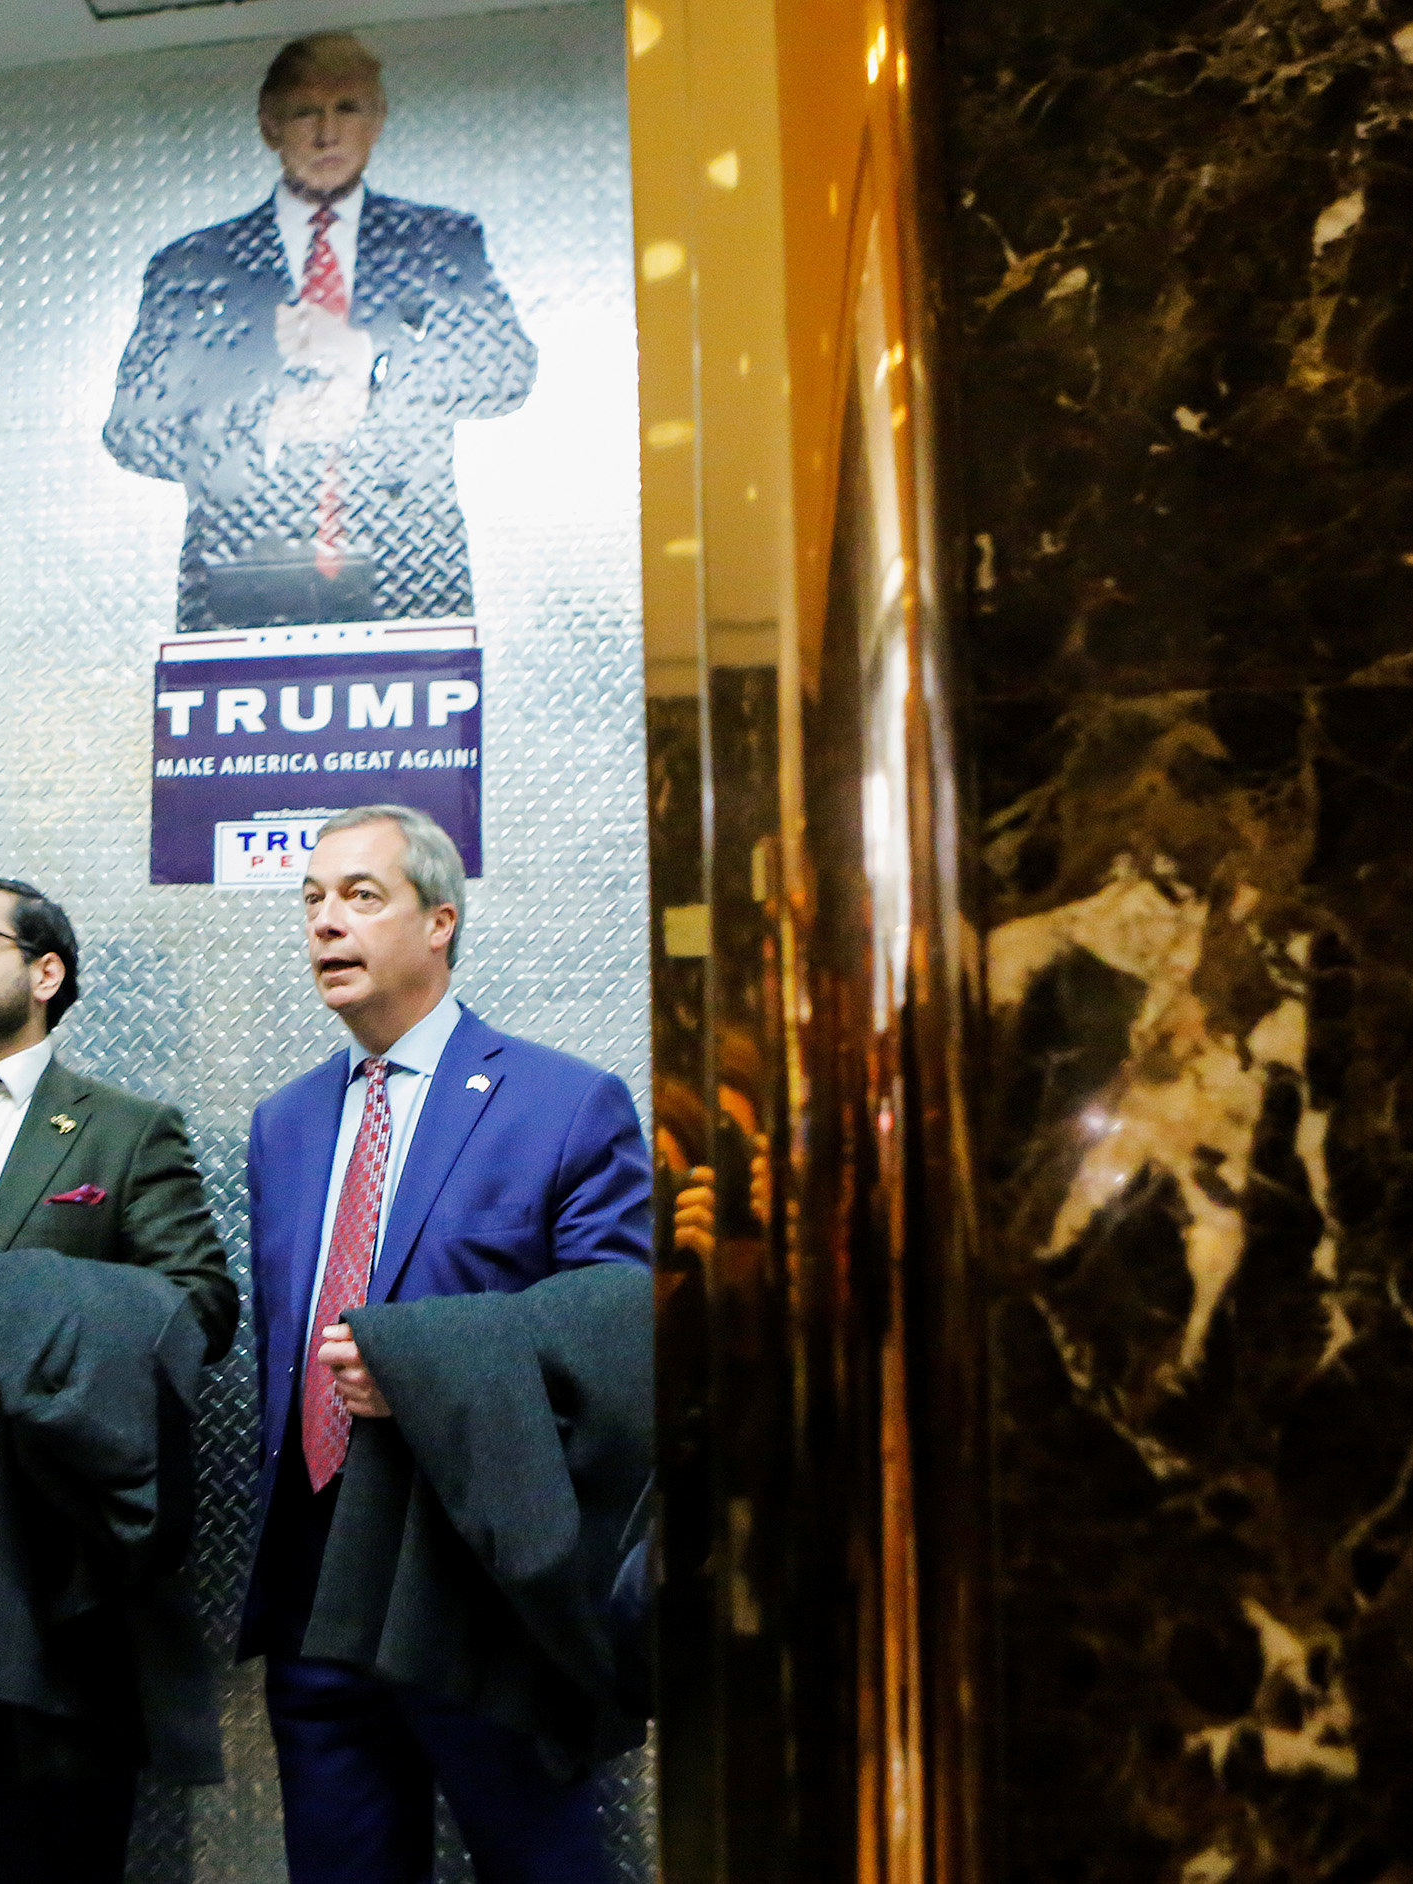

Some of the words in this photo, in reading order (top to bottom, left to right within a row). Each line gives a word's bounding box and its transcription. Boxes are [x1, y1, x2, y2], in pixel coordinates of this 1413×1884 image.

[156, 679, 480, 737] TRUMP
[155, 756, 216, 778] MAKE
[219, 752, 319, 775] AMERICA
[322, 750, 395, 773] GREAT
[398, 747, 478, 770] AGAIN!
[236, 829, 321, 852] TRU
